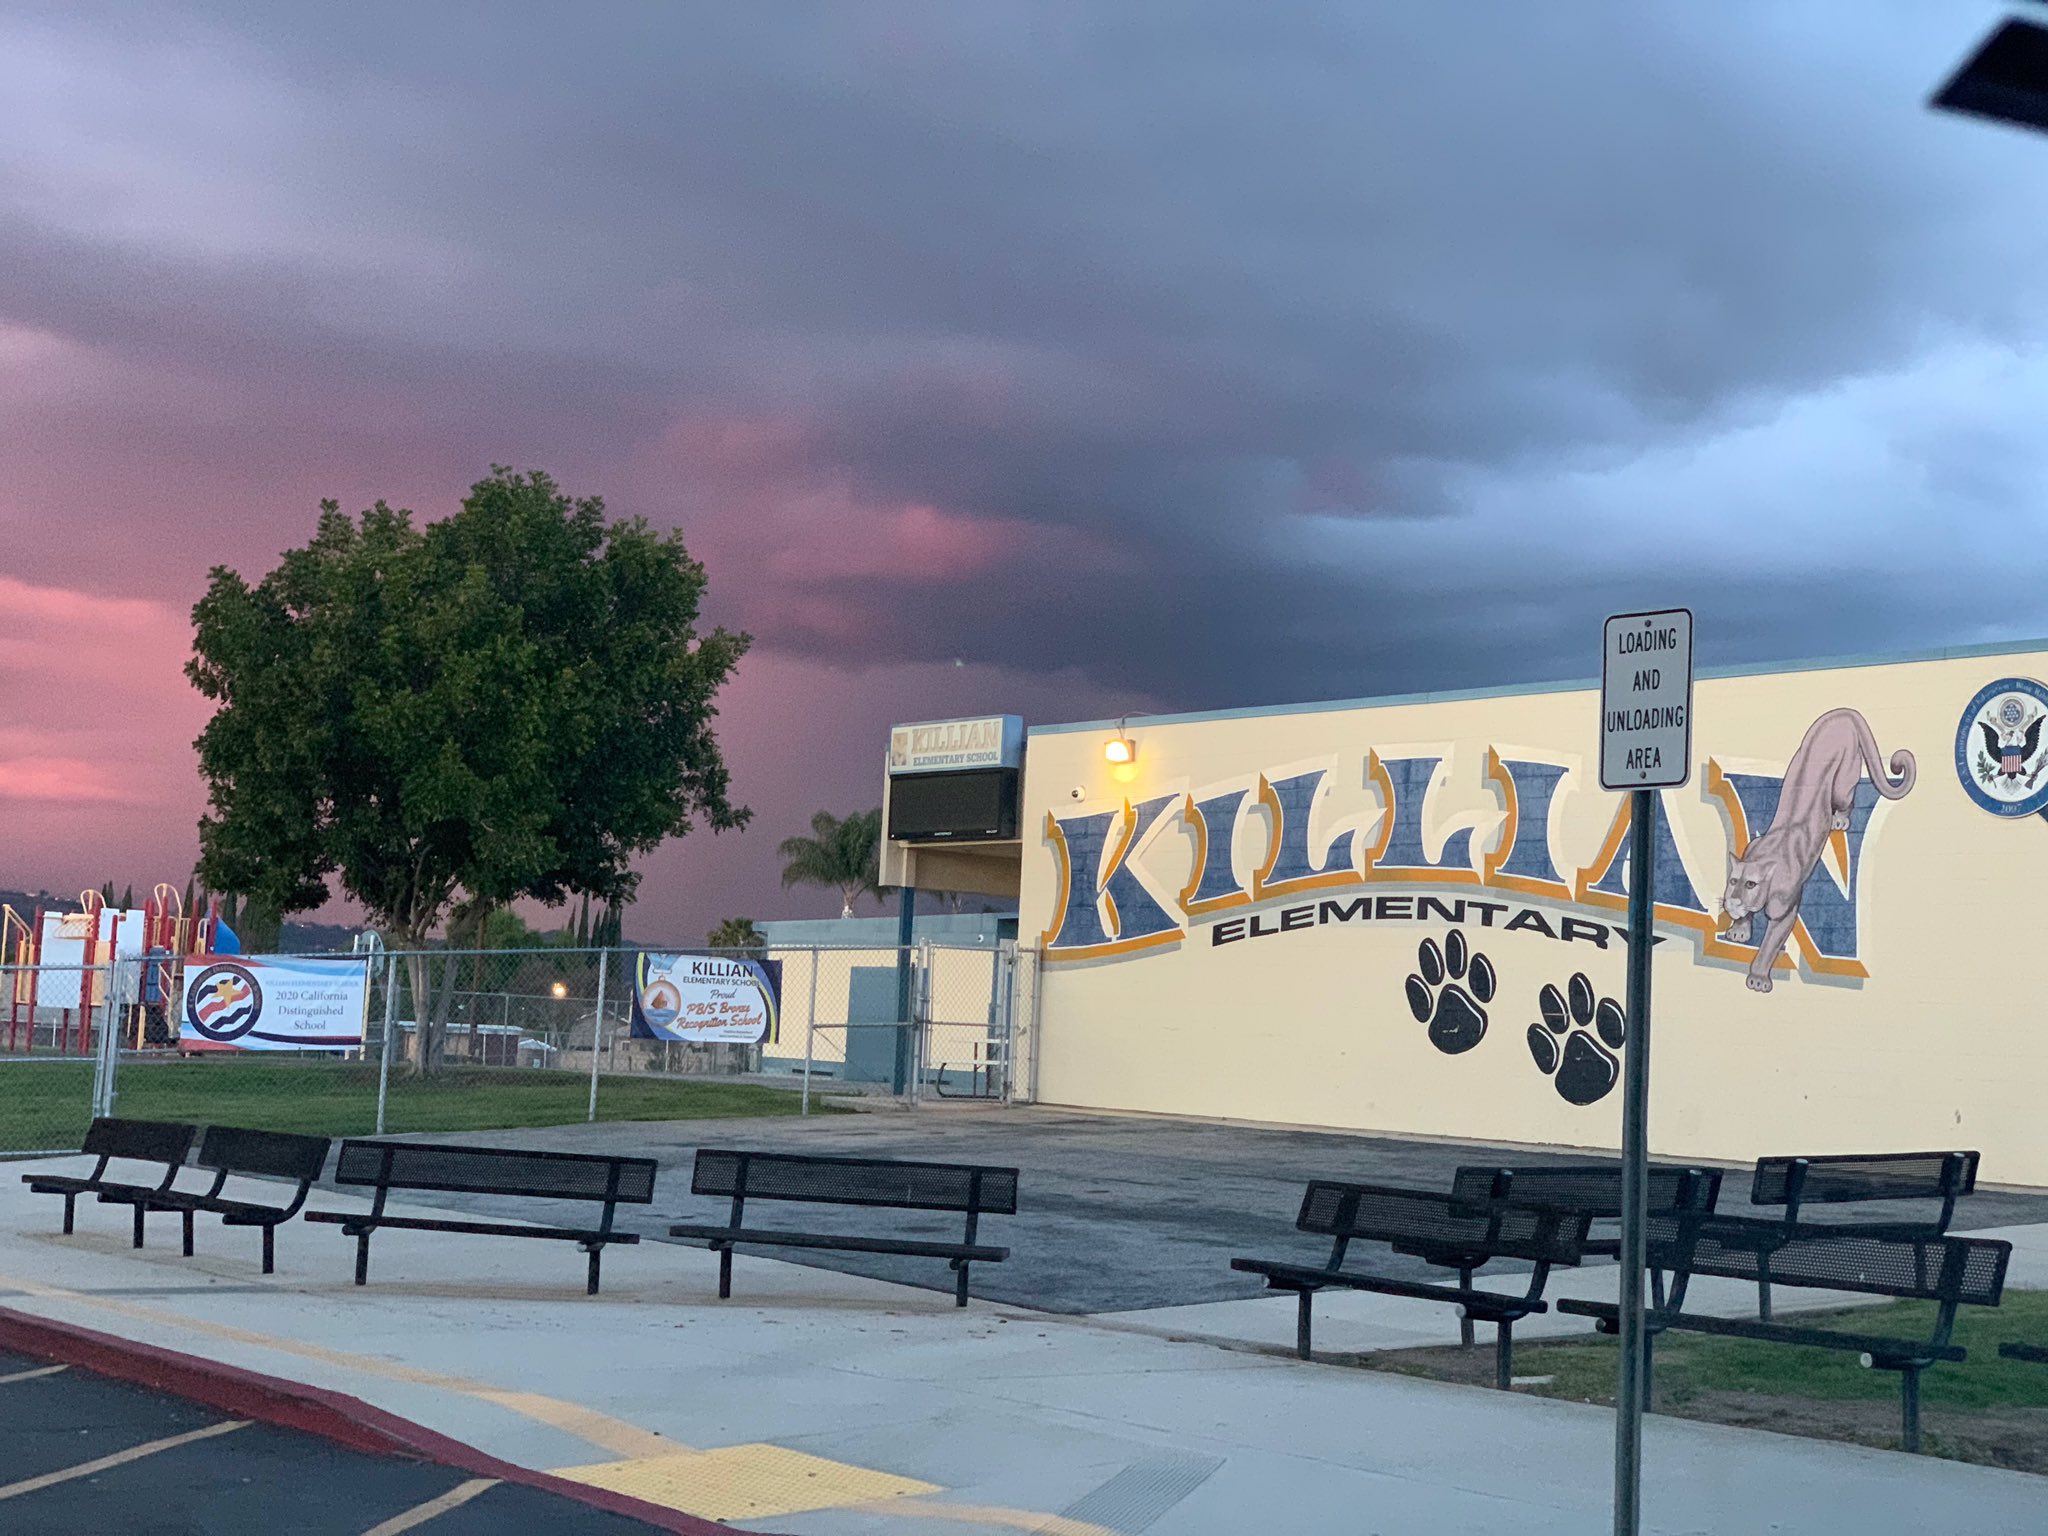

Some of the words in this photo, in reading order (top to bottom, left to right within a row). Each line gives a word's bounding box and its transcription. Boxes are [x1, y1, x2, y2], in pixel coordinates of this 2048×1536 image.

[1619, 628, 1677, 654] LOADING
[1633, 669, 1660, 692] AND
[1607, 705, 1684, 732] UNLOADING
[912, 721, 1000, 754] KILLIAN
[913, 754, 965, 766] ELEMENTARY
[966, 751, 998, 763] SCHOOL
[1626, 747, 1661, 769] AREA
[692, 961, 754, 977] KILLIAN
[683, 976, 730, 986] ELEMENTARY
[731, 978, 760, 987] SCHOOL
[276, 991, 298, 1000] 2020
[301, 990, 348, 1001] California
[710, 988, 738, 1000] Proud
[278, 1005, 344, 1017] Distinguished
[719, 1002, 751, 1014] Bronze
[294, 1020, 326, 1030] School
[676, 1016, 728, 1032] Recognition
[729, 1012, 763, 1026] School
